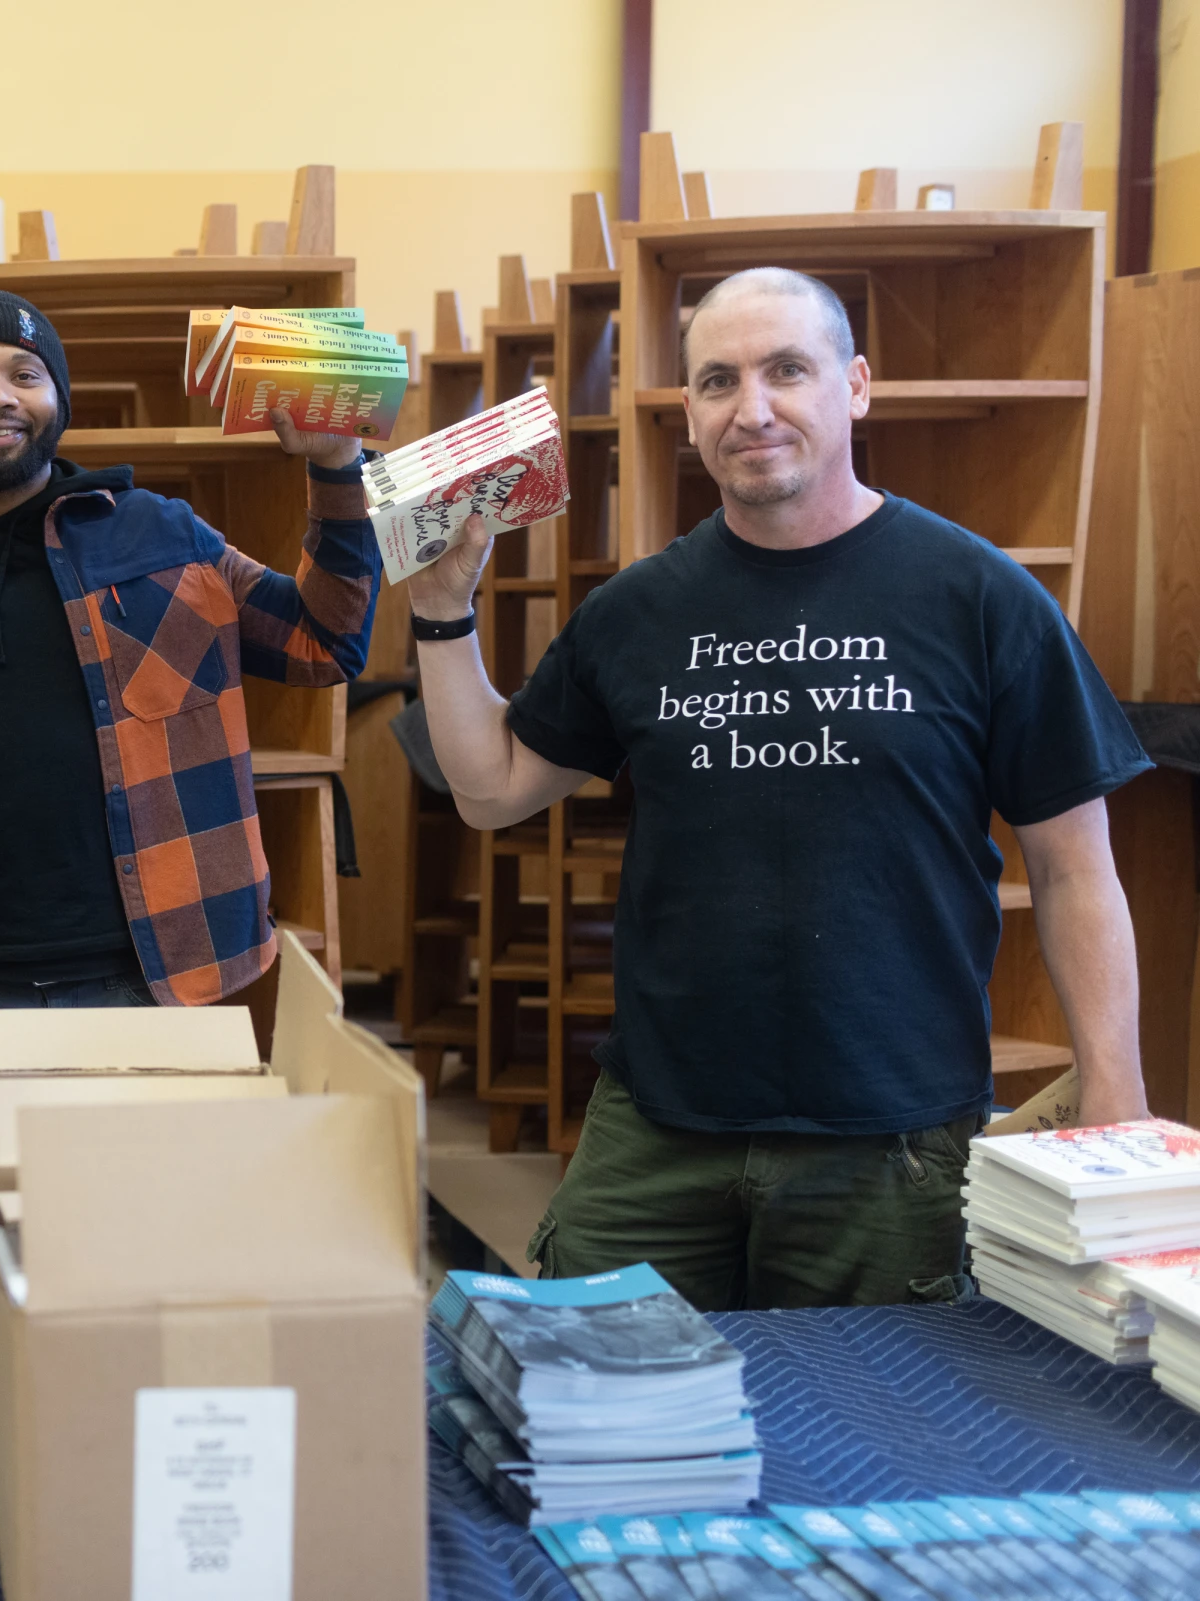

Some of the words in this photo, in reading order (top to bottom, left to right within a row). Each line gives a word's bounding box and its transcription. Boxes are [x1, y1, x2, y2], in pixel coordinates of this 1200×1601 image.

[259, 314, 285, 325] Gunty
[288, 319, 305, 328] Tess
[313, 324, 340, 333] Hutch
[262, 332, 289, 341] Gunty
[341, 329, 371, 340] Rabbit
[372, 333, 388, 343] The
[290, 336, 310, 345] Tess
[319, 339, 346, 348] Hutch
[350, 343, 379, 352] Rabbit
[381, 346, 398, 355] The
[260, 357, 288, 366] Gunty
[290, 359, 310, 368] Tess
[319, 361, 347, 370] Hutch
[351, 363, 381, 372] Rabbit
[383, 365, 400, 373] The
[244, 380, 277, 423] Gunty
[276, 387, 300, 411] Tes
[304, 383, 334, 424] Hutch
[328, 383, 360, 429] Rabbit
[355, 390, 383, 418] The
[685, 624, 888, 671] Freedom
[657, 679, 790, 729] begins
[805, 674, 916, 713] with
[690, 742, 713, 769] a
[729, 725, 860, 769] book.
